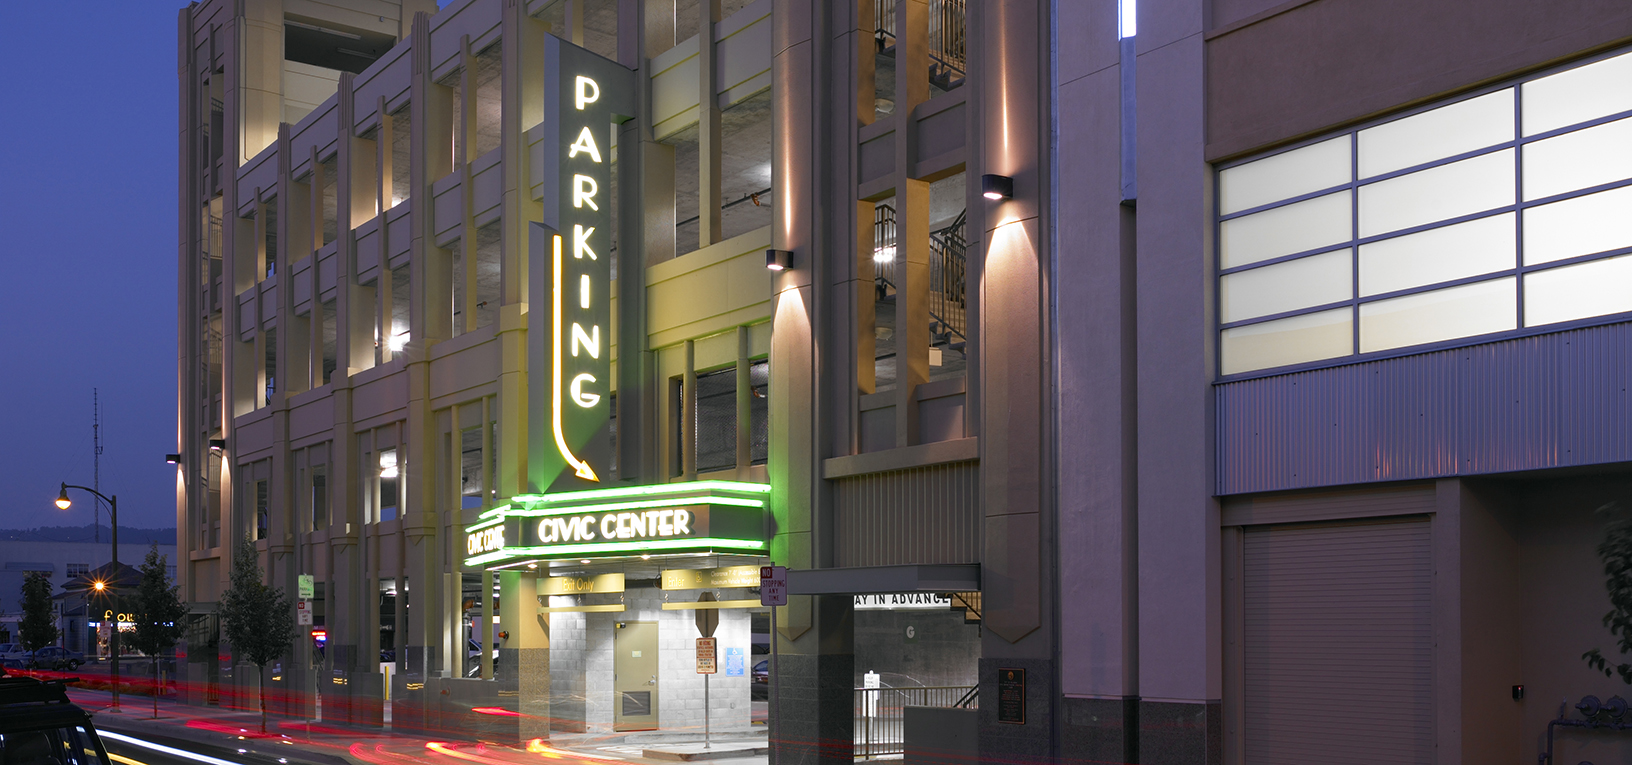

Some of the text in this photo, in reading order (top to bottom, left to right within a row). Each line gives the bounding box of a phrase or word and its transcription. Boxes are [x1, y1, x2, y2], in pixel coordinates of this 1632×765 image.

[569, 75, 602, 409] PARKING
[538, 509, 691, 543] CIVIC CENTER
[467, 531, 483, 555] CIVIC
[762, 568, 771, 577] NO
[562, 577, 595, 592] Exit Only
[667, 576, 685, 587] Enter
[762, 579, 785, 588] STOPPING
[768, 594, 779, 602] TIME
[873, 594, 886, 604] IN
[905, 625, 915, 639] G
